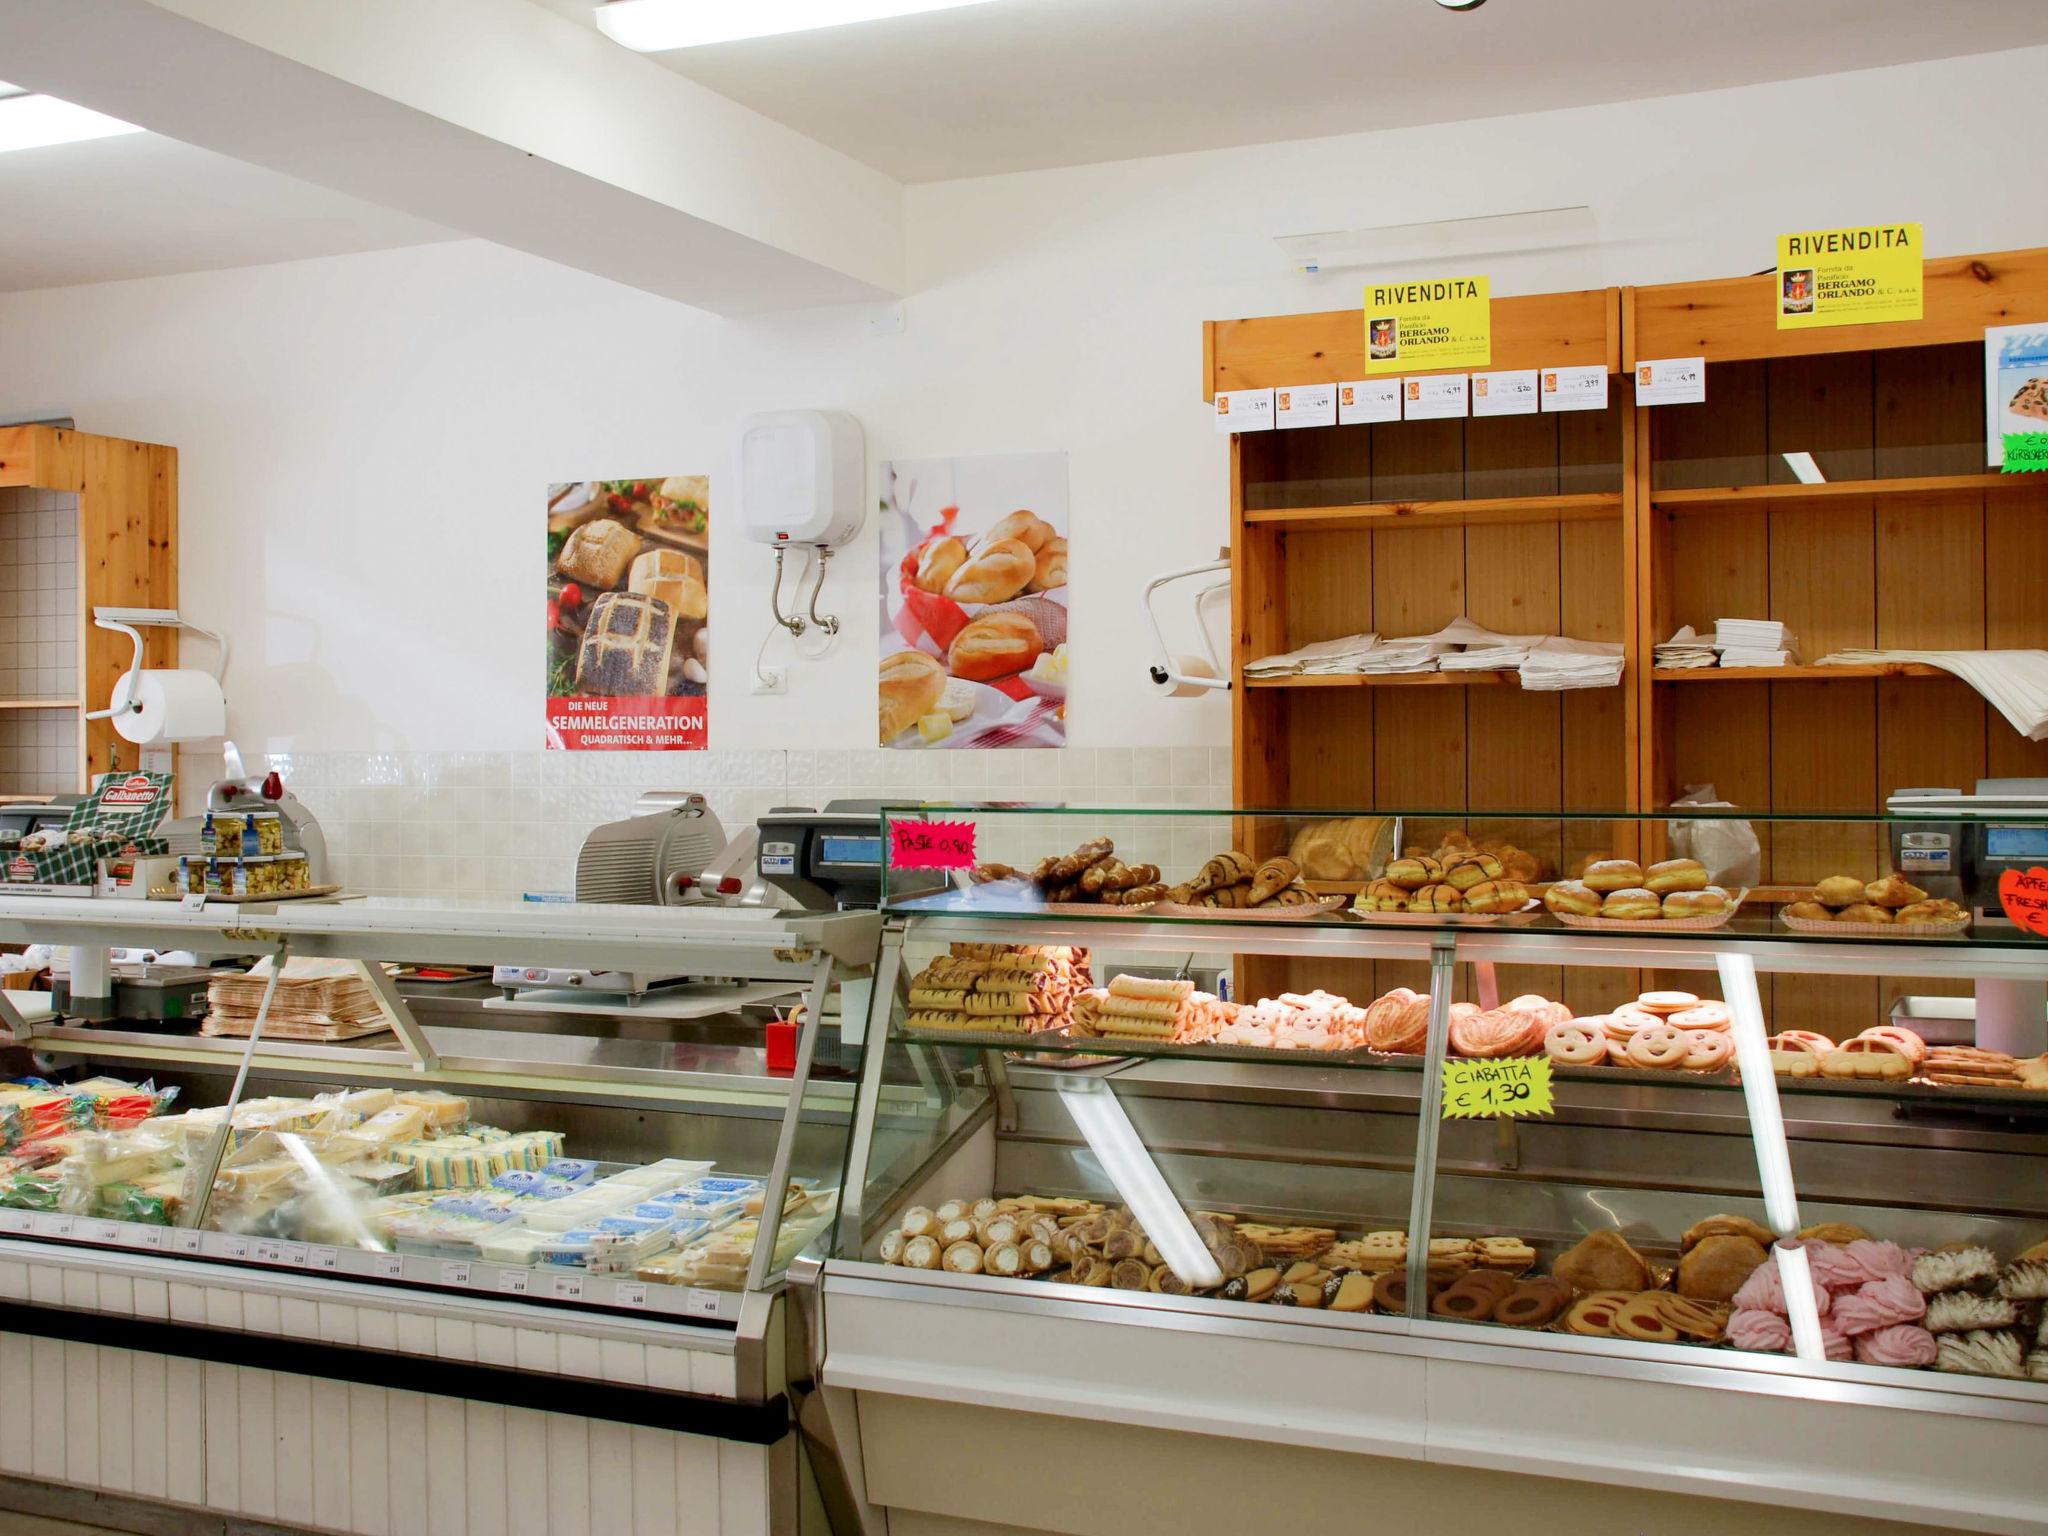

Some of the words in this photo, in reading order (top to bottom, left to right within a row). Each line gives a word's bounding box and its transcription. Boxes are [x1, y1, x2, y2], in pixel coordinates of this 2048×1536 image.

[1789, 228, 1909, 256] RIVENDITA
[1818, 278, 1876, 291] BERGAMO
[1375, 280, 1478, 306] RIVENDITA
[1818, 287, 1875, 300] ORLANDO
[1399, 326, 1450, 338] BERGAMO
[1399, 335, 1449, 347] ORLANDO
[568, 701, 583, 711] DIE
[584, 701, 609, 711] NEUE
[552, 715, 704, 731] SEMMELGENERATION
[580, 734, 644, 745] QUADRATISCH
[645, 734, 654, 744] &
[104, 789, 155, 801] Galbanetto
[2026, 912, 2043, 924] €
[1454, 1065, 1532, 1084] CIABATTA
[1454, 1092, 1471, 1107] €
[1480, 1082, 1531, 1106] 1,30
